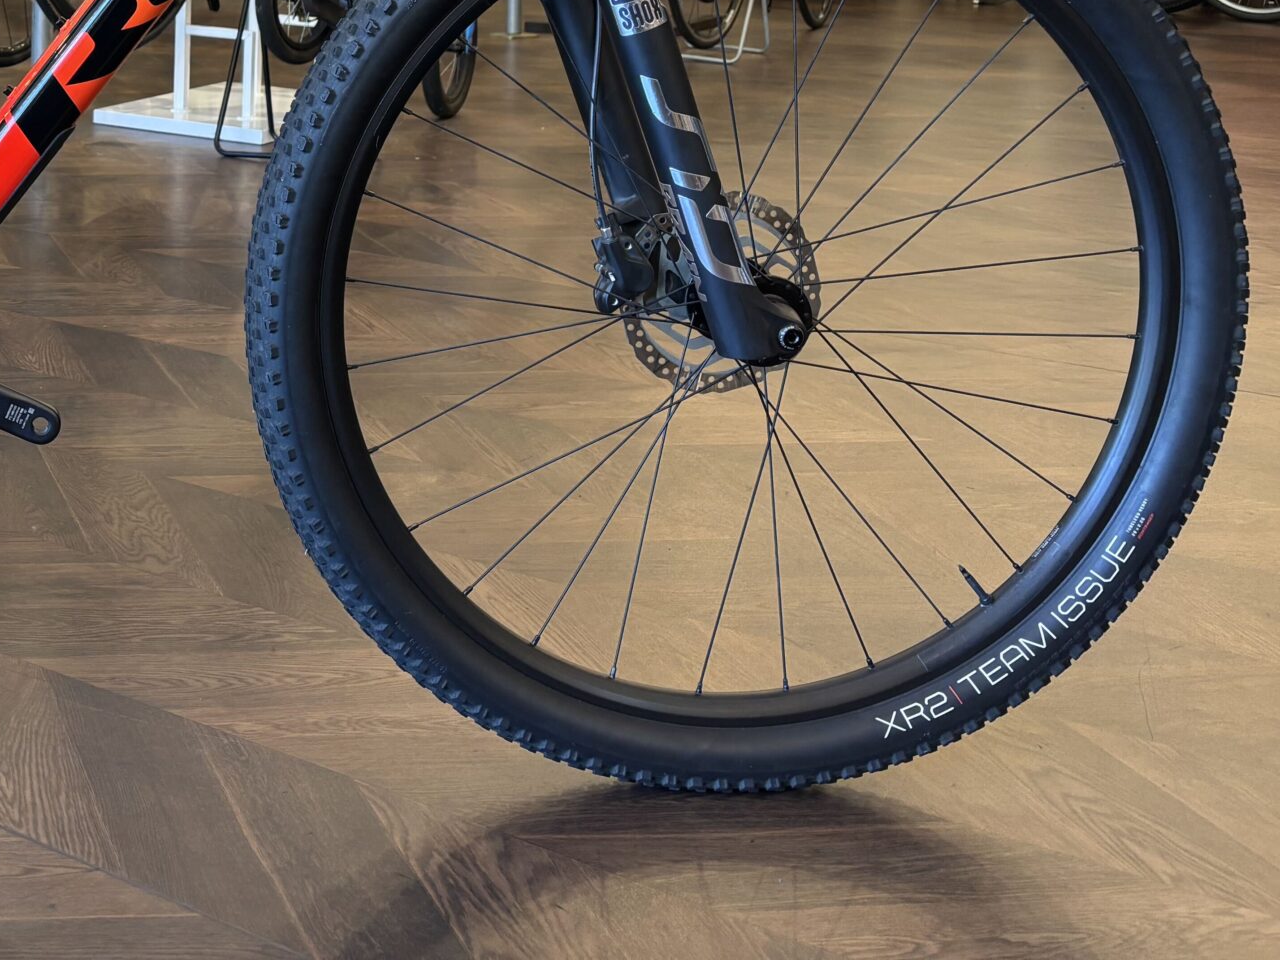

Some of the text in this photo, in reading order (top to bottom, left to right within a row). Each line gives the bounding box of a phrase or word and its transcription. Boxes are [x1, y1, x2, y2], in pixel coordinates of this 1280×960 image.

[875, 691, 955, 739] XR2
[957, 622, 1057, 695] TEAM
[1050, 535, 1136, 629] ISSUE
